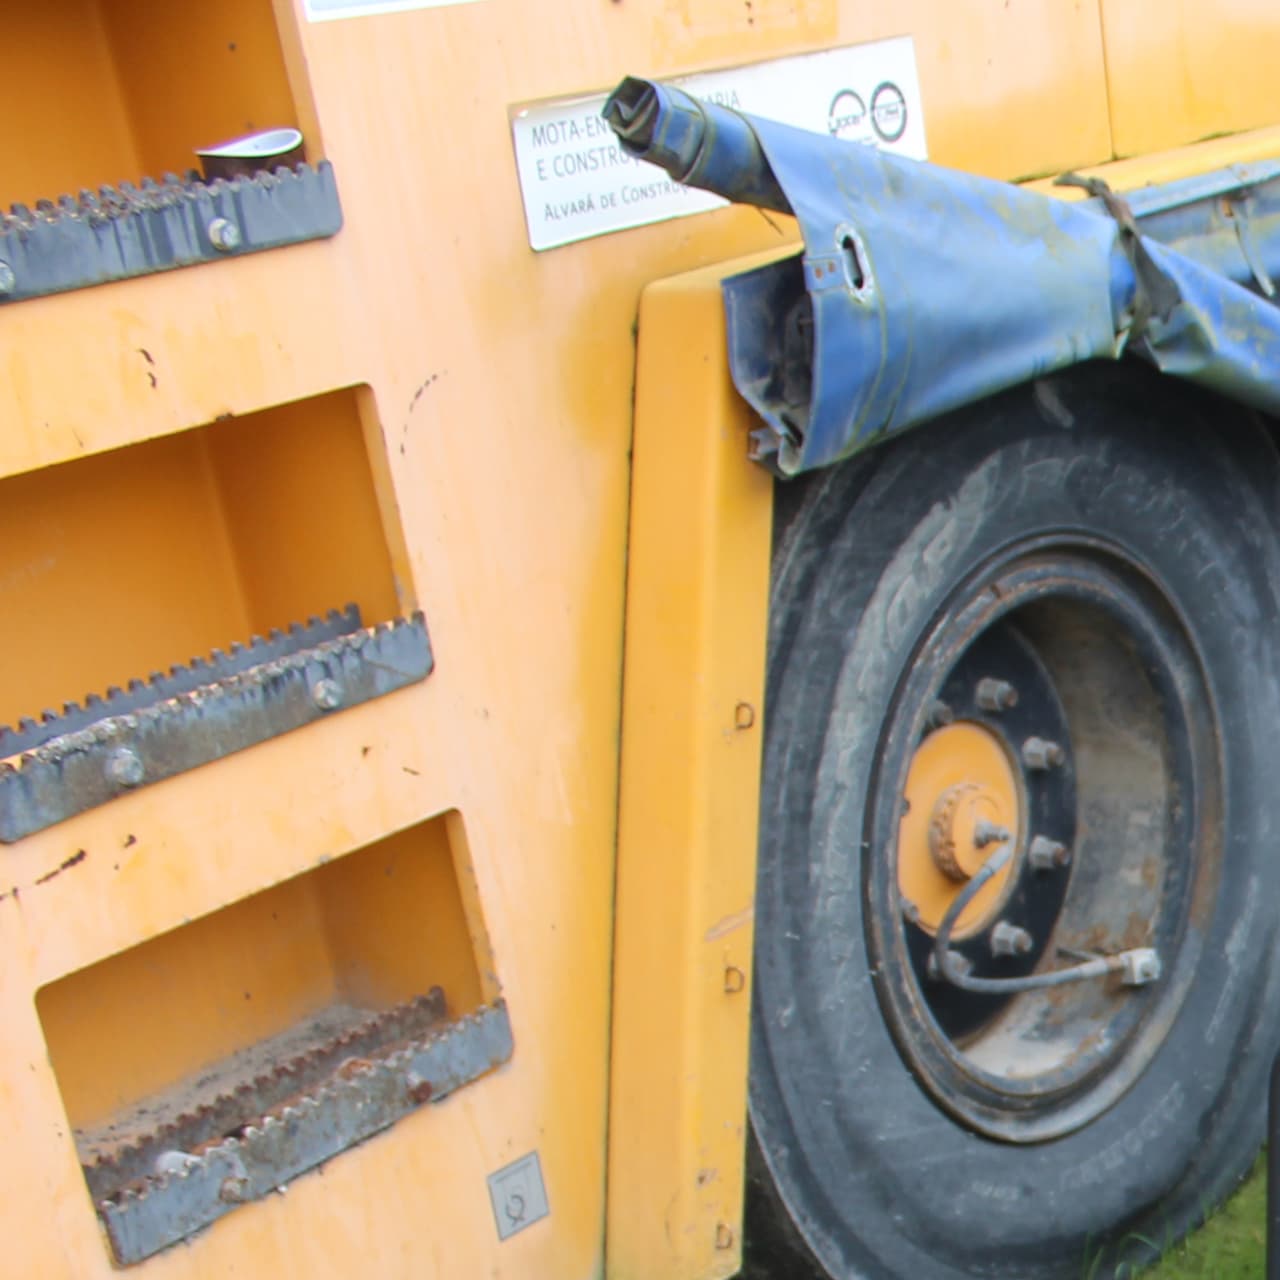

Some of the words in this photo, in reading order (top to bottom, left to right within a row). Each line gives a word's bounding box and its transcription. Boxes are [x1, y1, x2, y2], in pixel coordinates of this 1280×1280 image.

[531, 114, 609, 149] MOTA-EN
[536, 158, 549, 182] E
[553, 145, 639, 176] CONSTRU
[600, 194, 617, 208] DE
